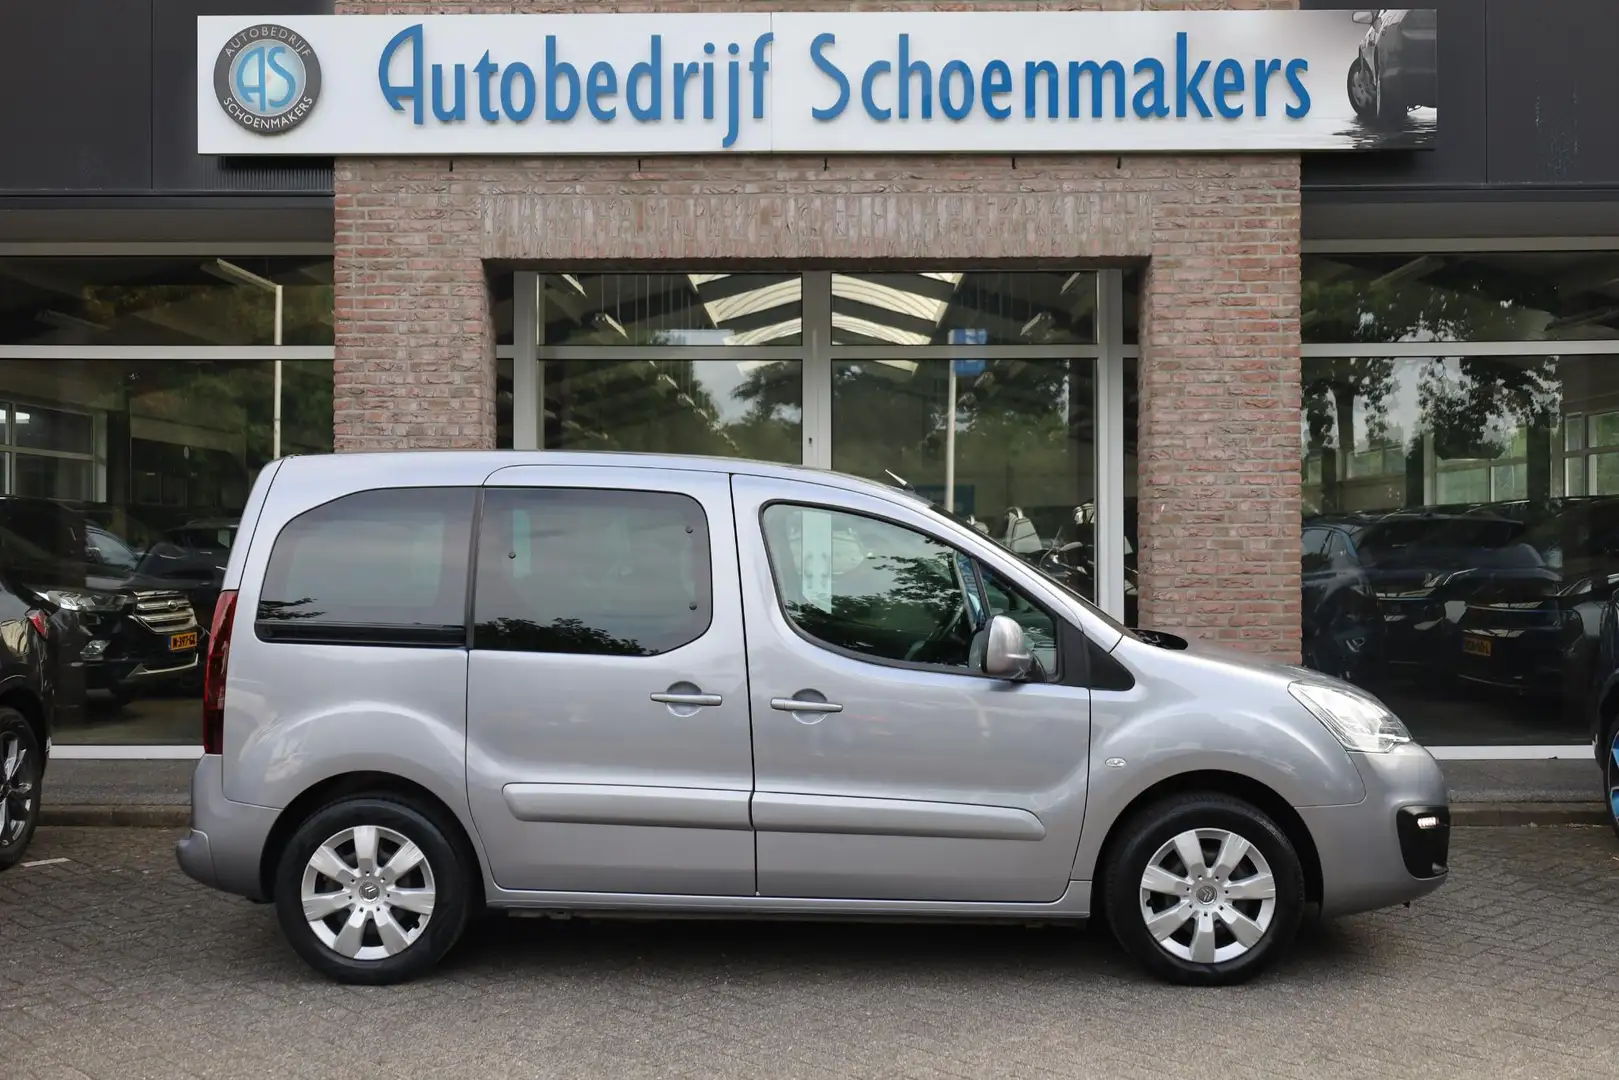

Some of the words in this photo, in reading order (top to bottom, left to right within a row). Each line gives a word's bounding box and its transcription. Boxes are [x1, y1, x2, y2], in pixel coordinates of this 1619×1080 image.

[224, 26, 312, 57] AUTOBEDRIJF
[236, 46, 296, 112] AS
[378, 24, 774, 148] Autobedrijf
[810, 32, 1311, 121] Schoenmakers
[223, 96, 313, 129] SCHOENMAKERS
